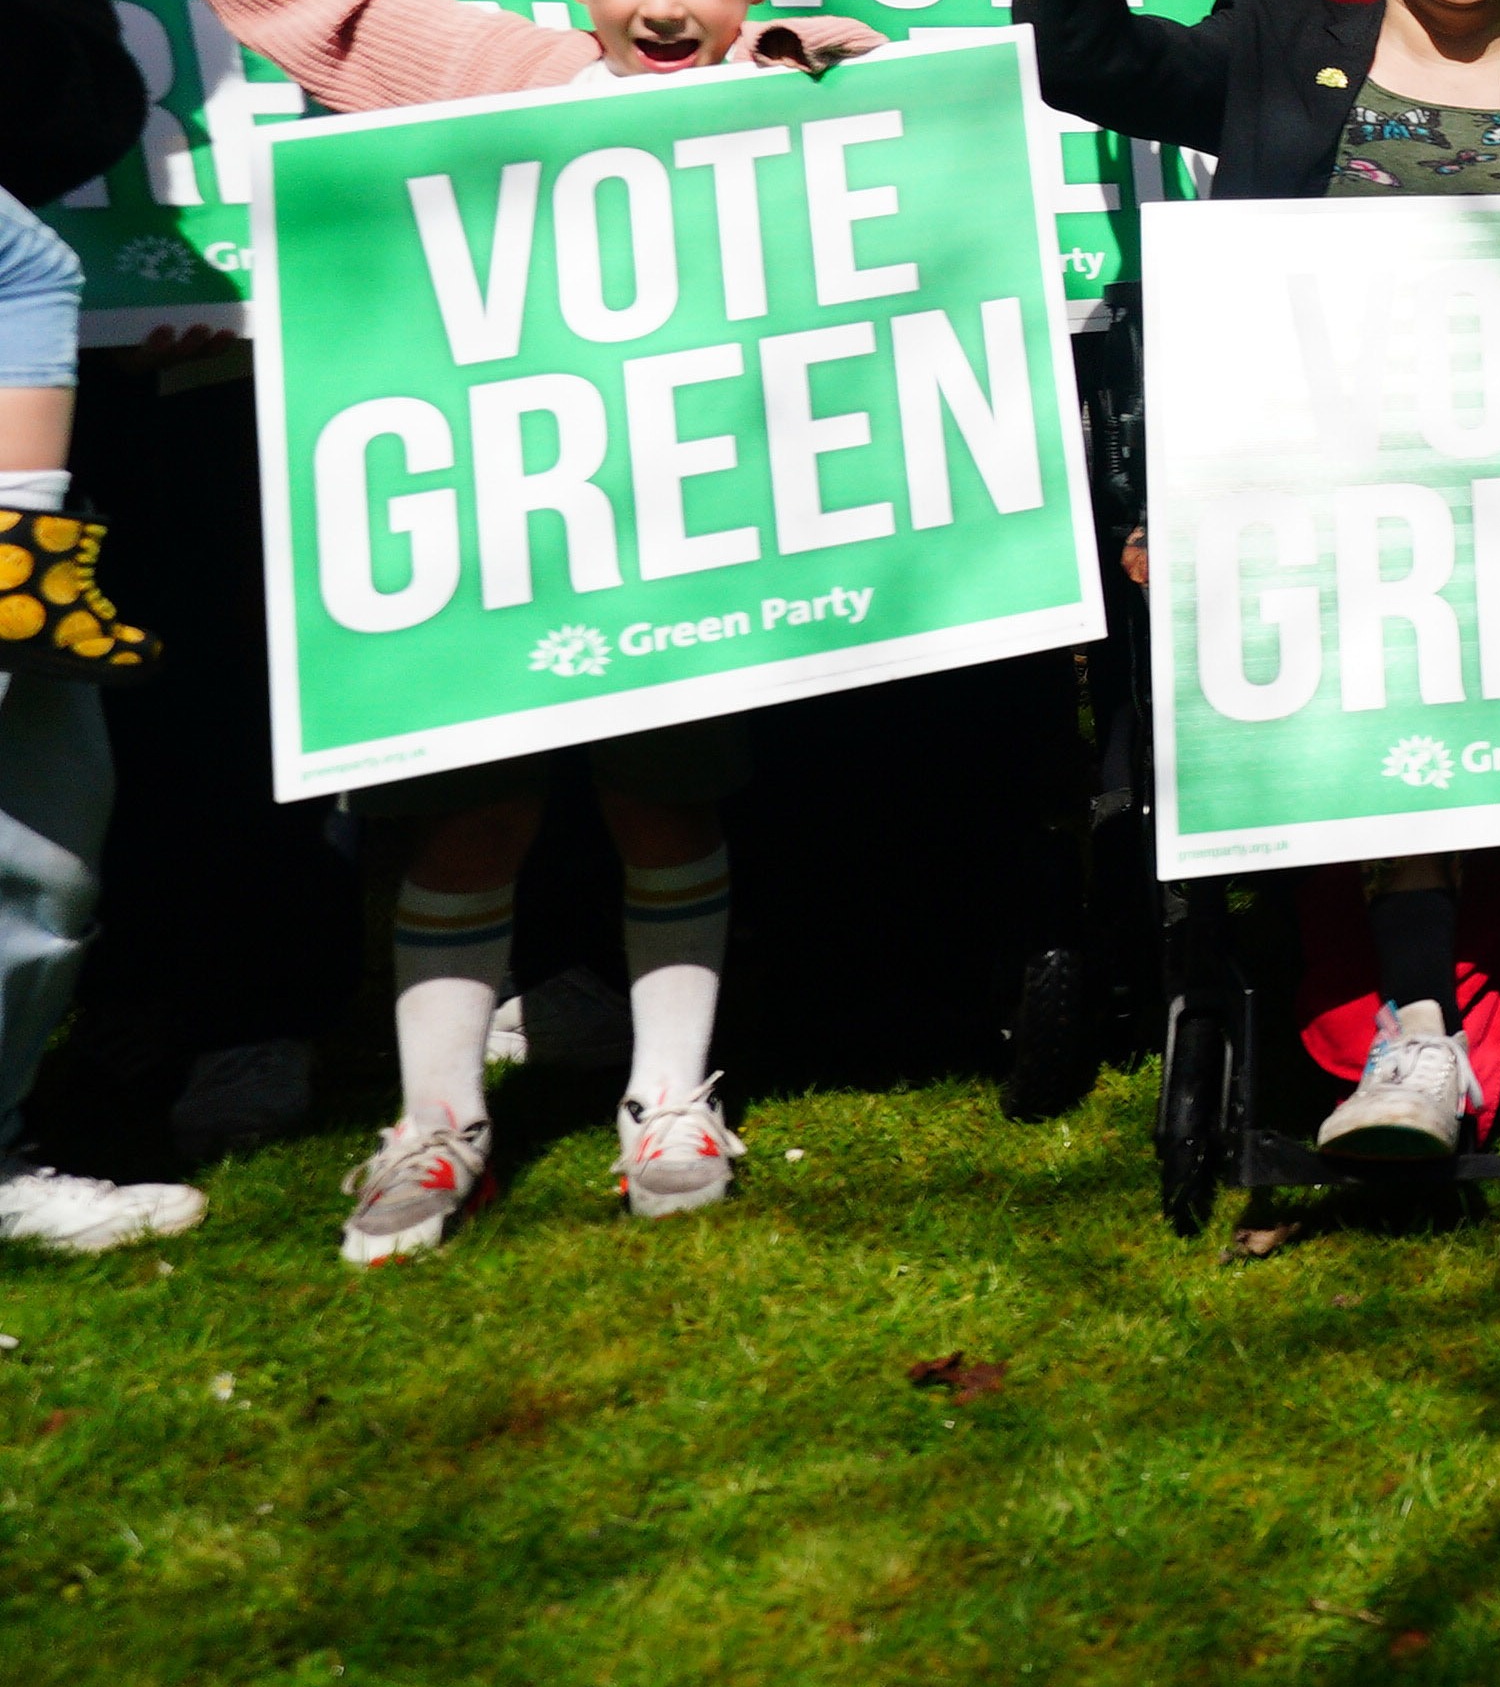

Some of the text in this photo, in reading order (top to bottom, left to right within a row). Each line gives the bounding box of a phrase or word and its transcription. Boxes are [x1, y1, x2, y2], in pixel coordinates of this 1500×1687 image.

[406, 109, 919, 366] VOTE
[1060, 247, 1106, 280] rty
[313, 297, 1044, 634] GREEN
[619, 610, 750, 659] Green
[761, 584, 875, 635] Party
